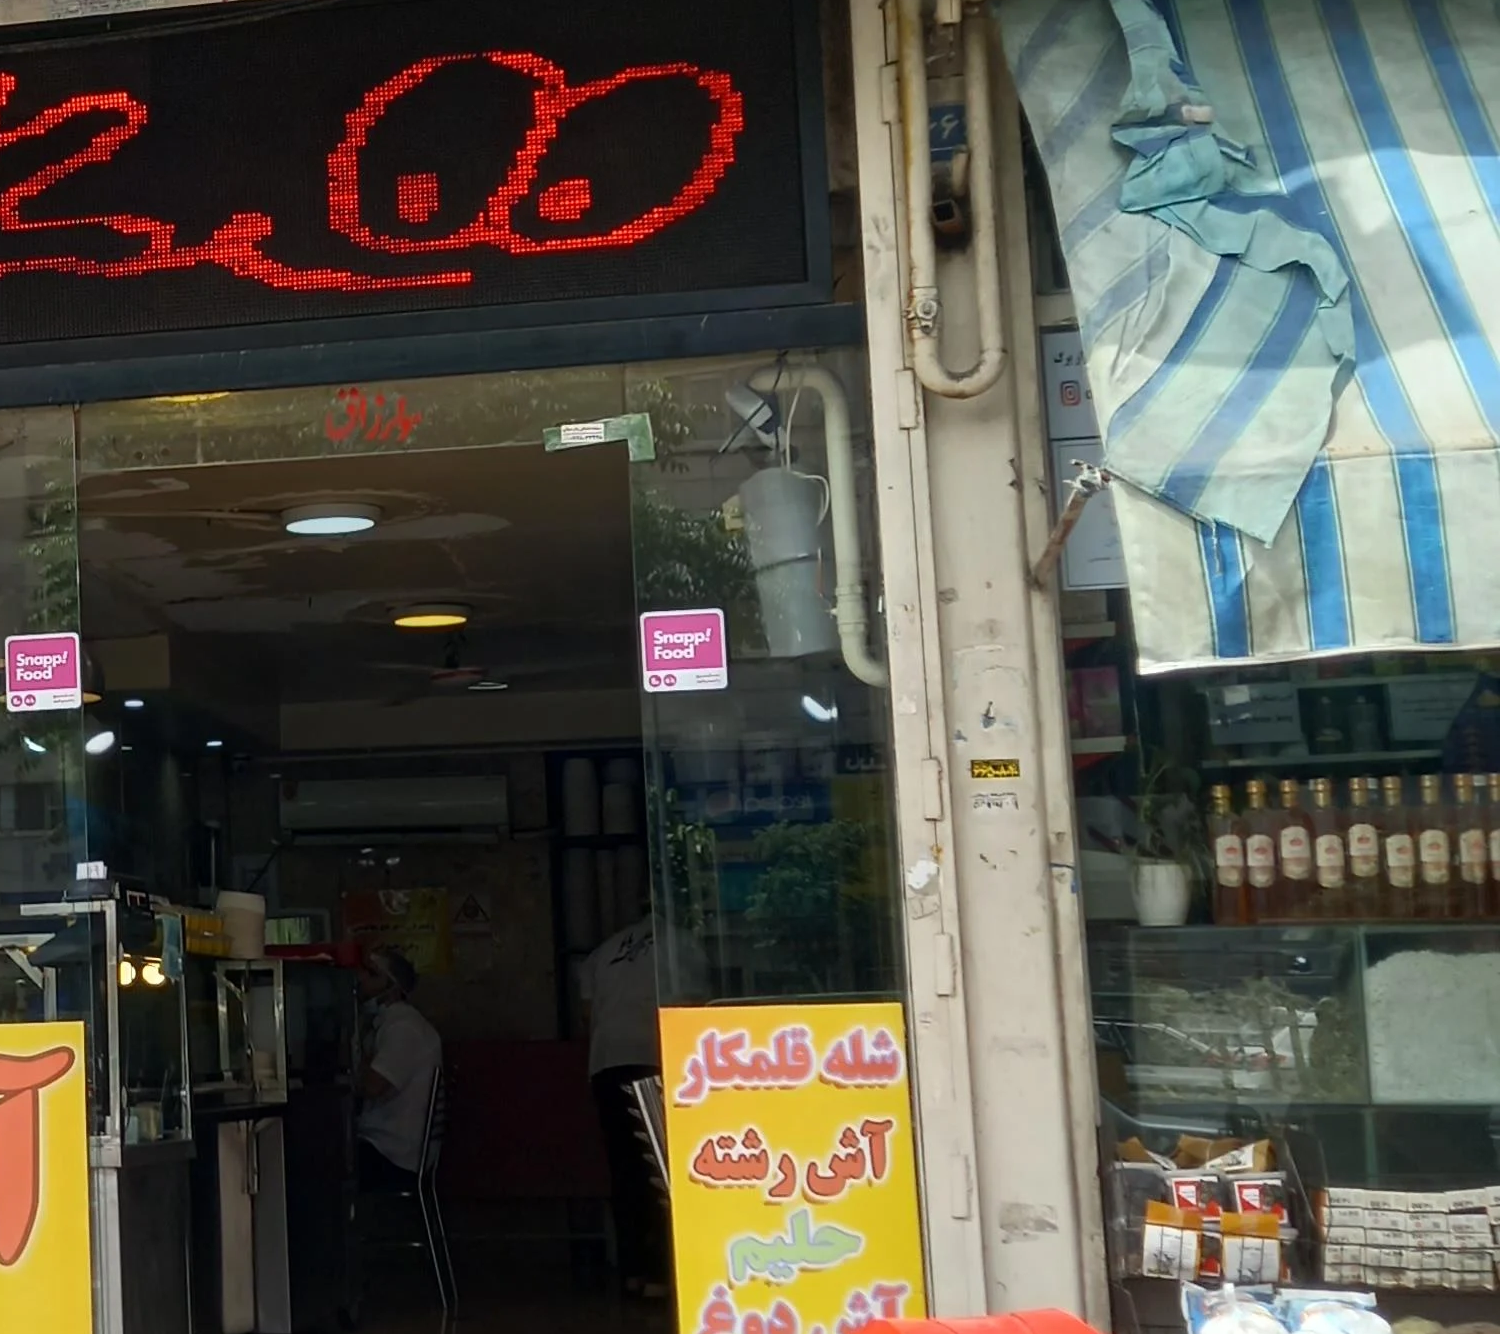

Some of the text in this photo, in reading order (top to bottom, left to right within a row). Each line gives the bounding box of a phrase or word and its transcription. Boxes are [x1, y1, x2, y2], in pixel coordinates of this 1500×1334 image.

[653, 627, 712, 646] Snapp!
[16, 650, 69, 668] Snapp!
[653, 644, 695, 660] Food
[16, 667, 53, 681] Food
[676, 1025, 902, 1101] شله قلمکار
[692, 1118, 894, 1199] آش رشته
[729, 1207, 863, 1283] حلیم
